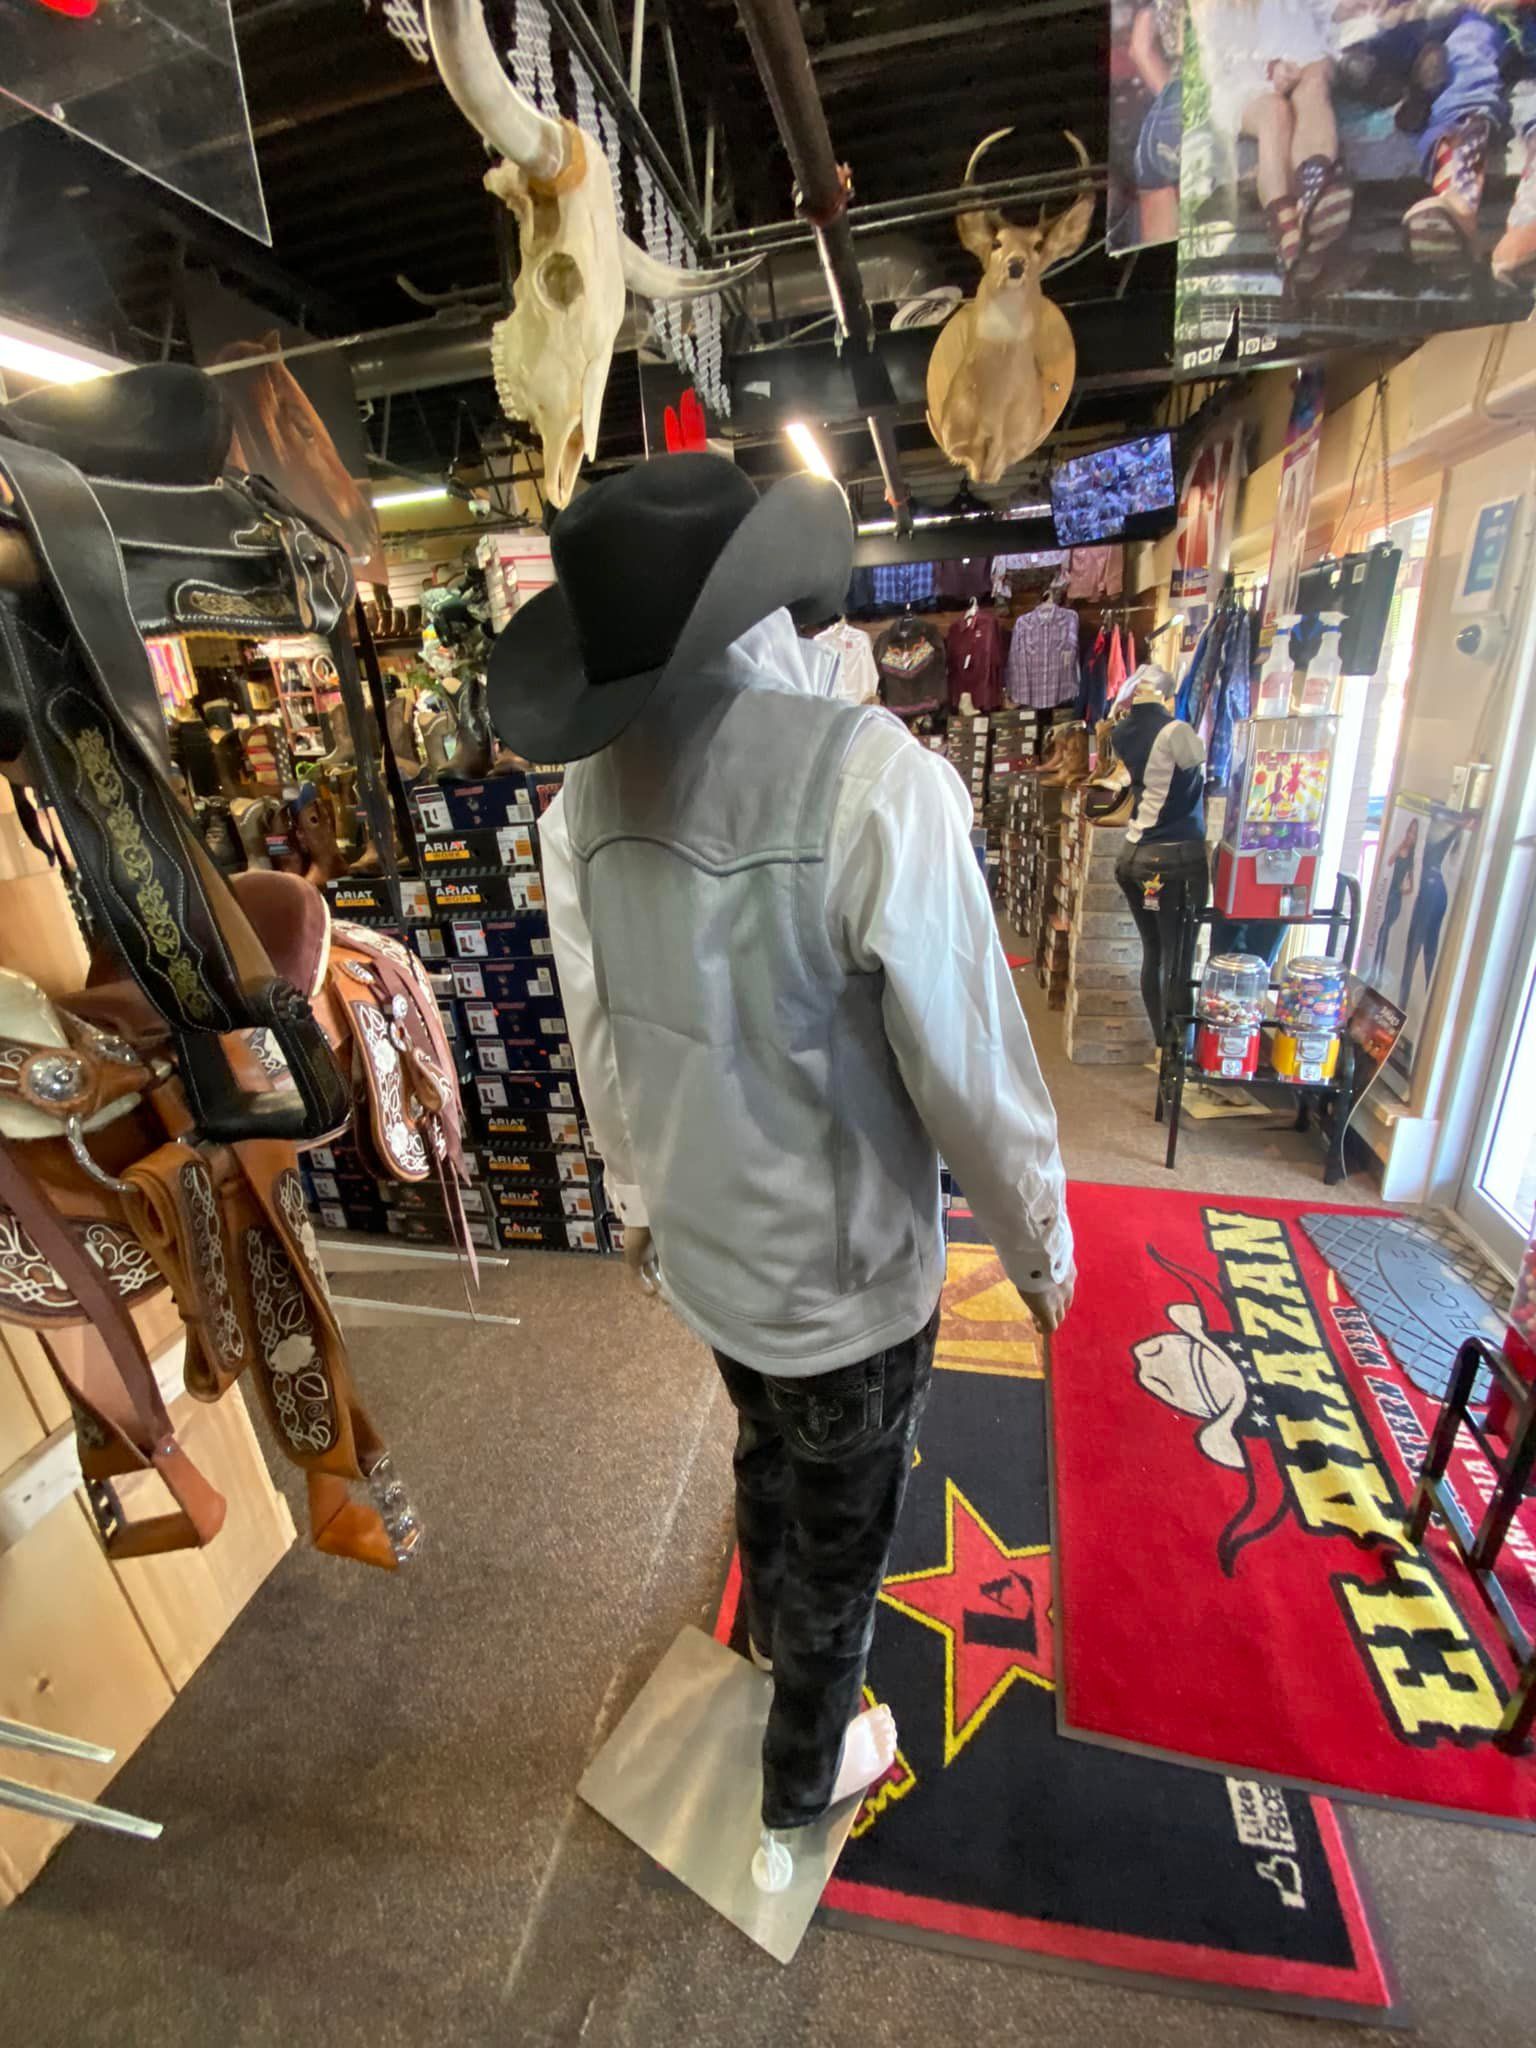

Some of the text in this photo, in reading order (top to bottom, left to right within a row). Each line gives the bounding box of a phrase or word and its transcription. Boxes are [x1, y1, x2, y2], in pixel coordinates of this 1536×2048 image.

[424, 841, 467, 852] ARIAT
[335, 890, 373, 900] ARIAT
[436, 885, 478, 896] ARIAT
[488, 1118, 524, 1126] ARIAT
[489, 1156, 528, 1164] ARIAT
[500, 1192, 536, 1200] ARIAT
[504, 1226, 541, 1234] ARIAT
[1330, 1305, 1391, 1370] WEAR
[1207, 1208, 1504, 1732] EL ALAZAN
[1238, 1785, 1262, 1839] Like
[1261, 1783, 1295, 1845] Face
